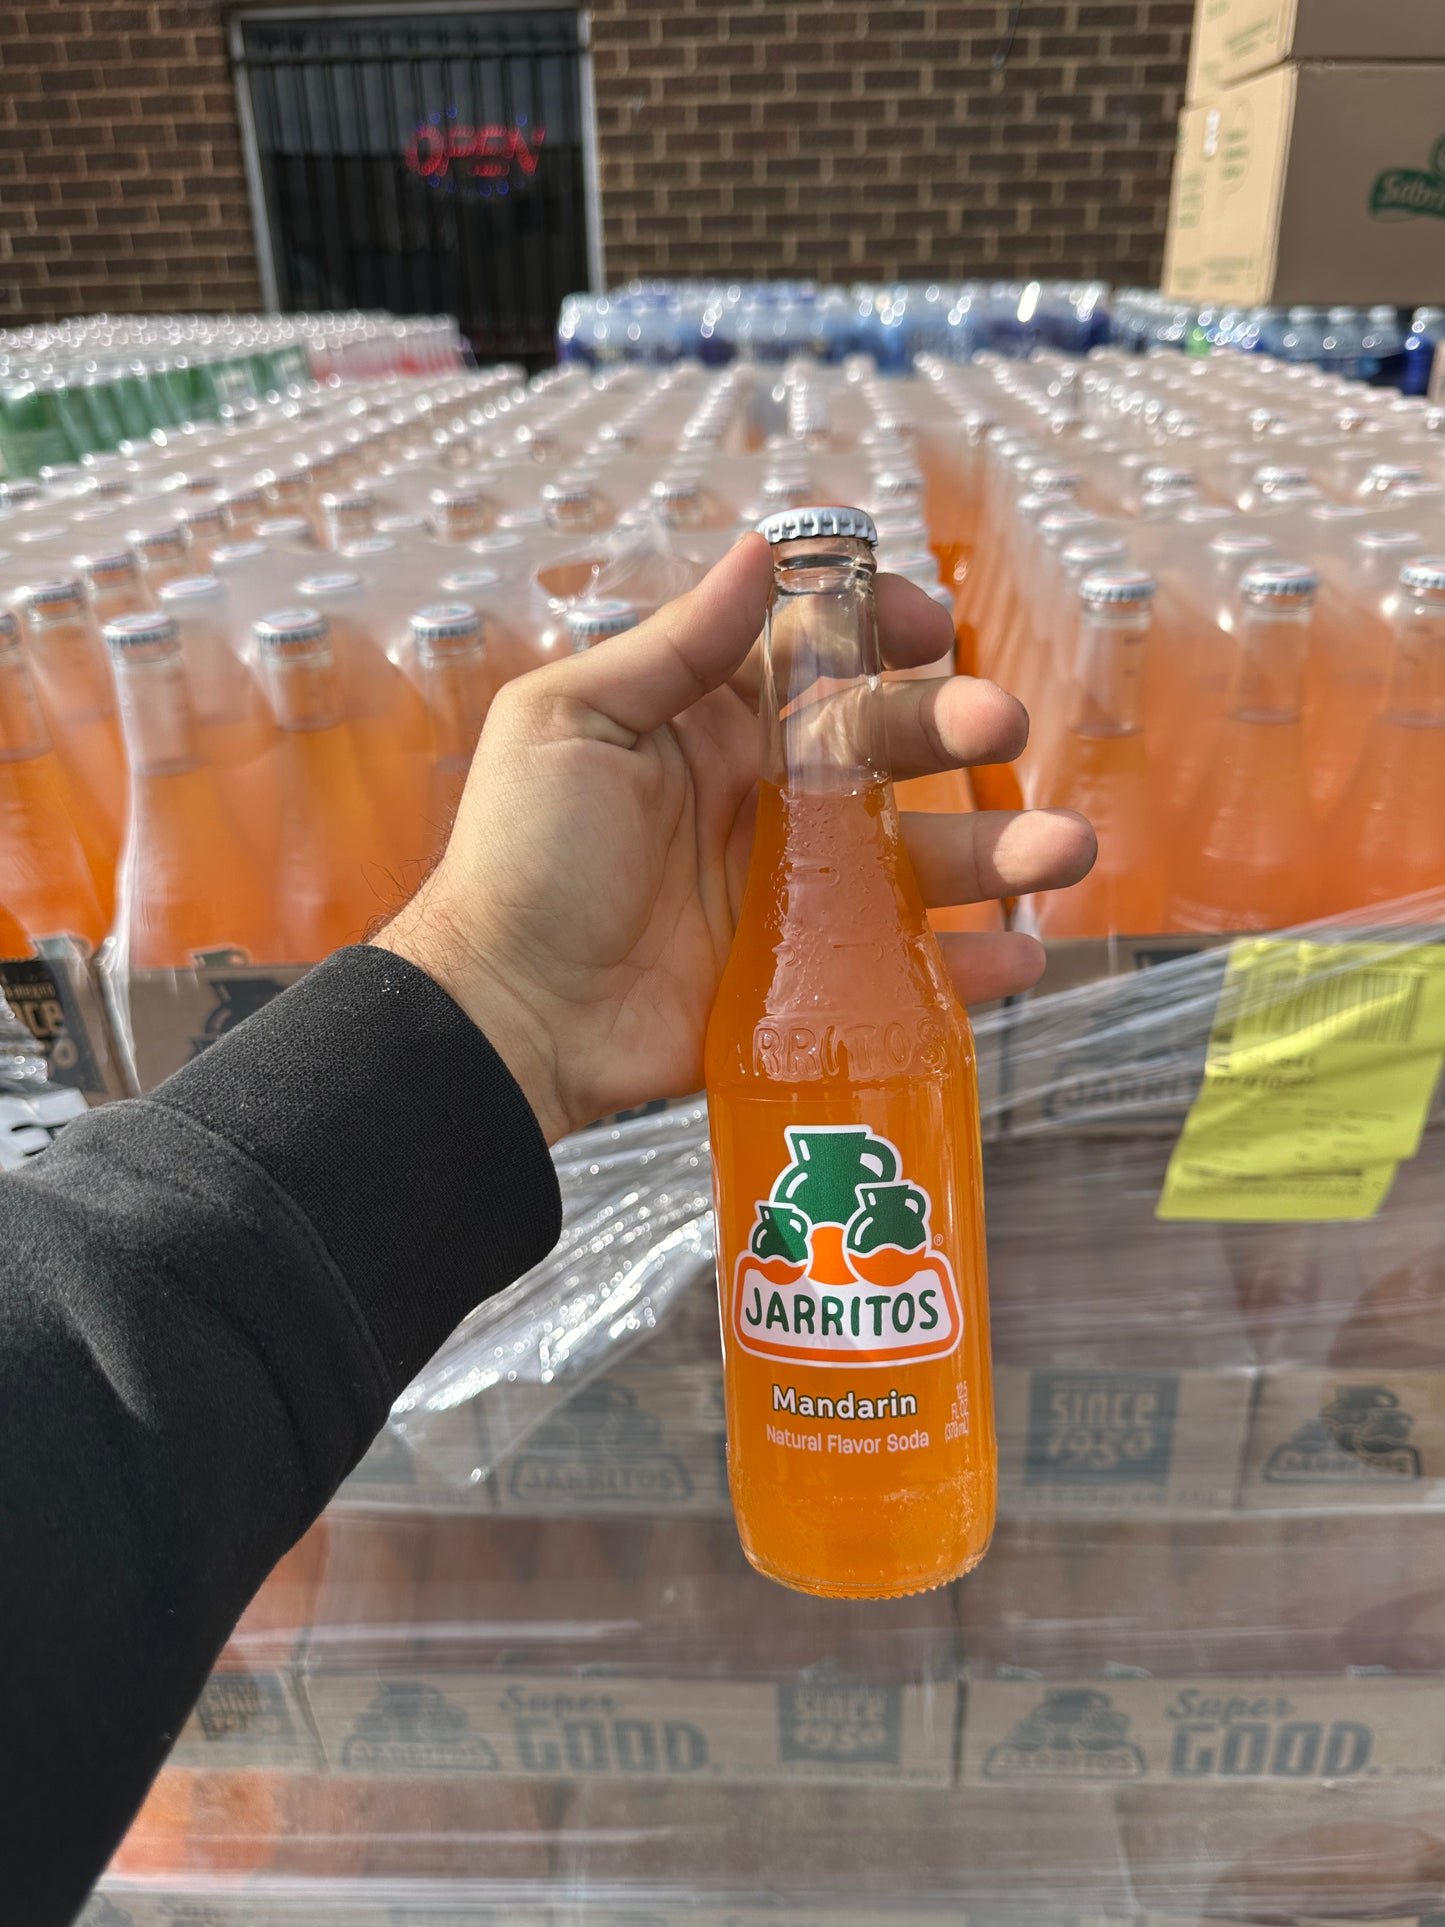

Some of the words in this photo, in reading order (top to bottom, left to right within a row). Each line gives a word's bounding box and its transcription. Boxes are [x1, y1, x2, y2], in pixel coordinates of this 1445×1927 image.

[405, 124, 546, 177] OPEN
[752, 1021, 949, 1082] RRITOS
[745, 1287, 938, 1337] JARRITOS
[772, 1384, 918, 1420] Mandarin
[766, 1423, 822, 1452] Natural
[827, 1434, 881, 1454] Flavor
[887, 1429, 929, 1451] Soda
[502, 1683, 616, 1718] Super
[1166, 1687, 1300, 1724] Super
